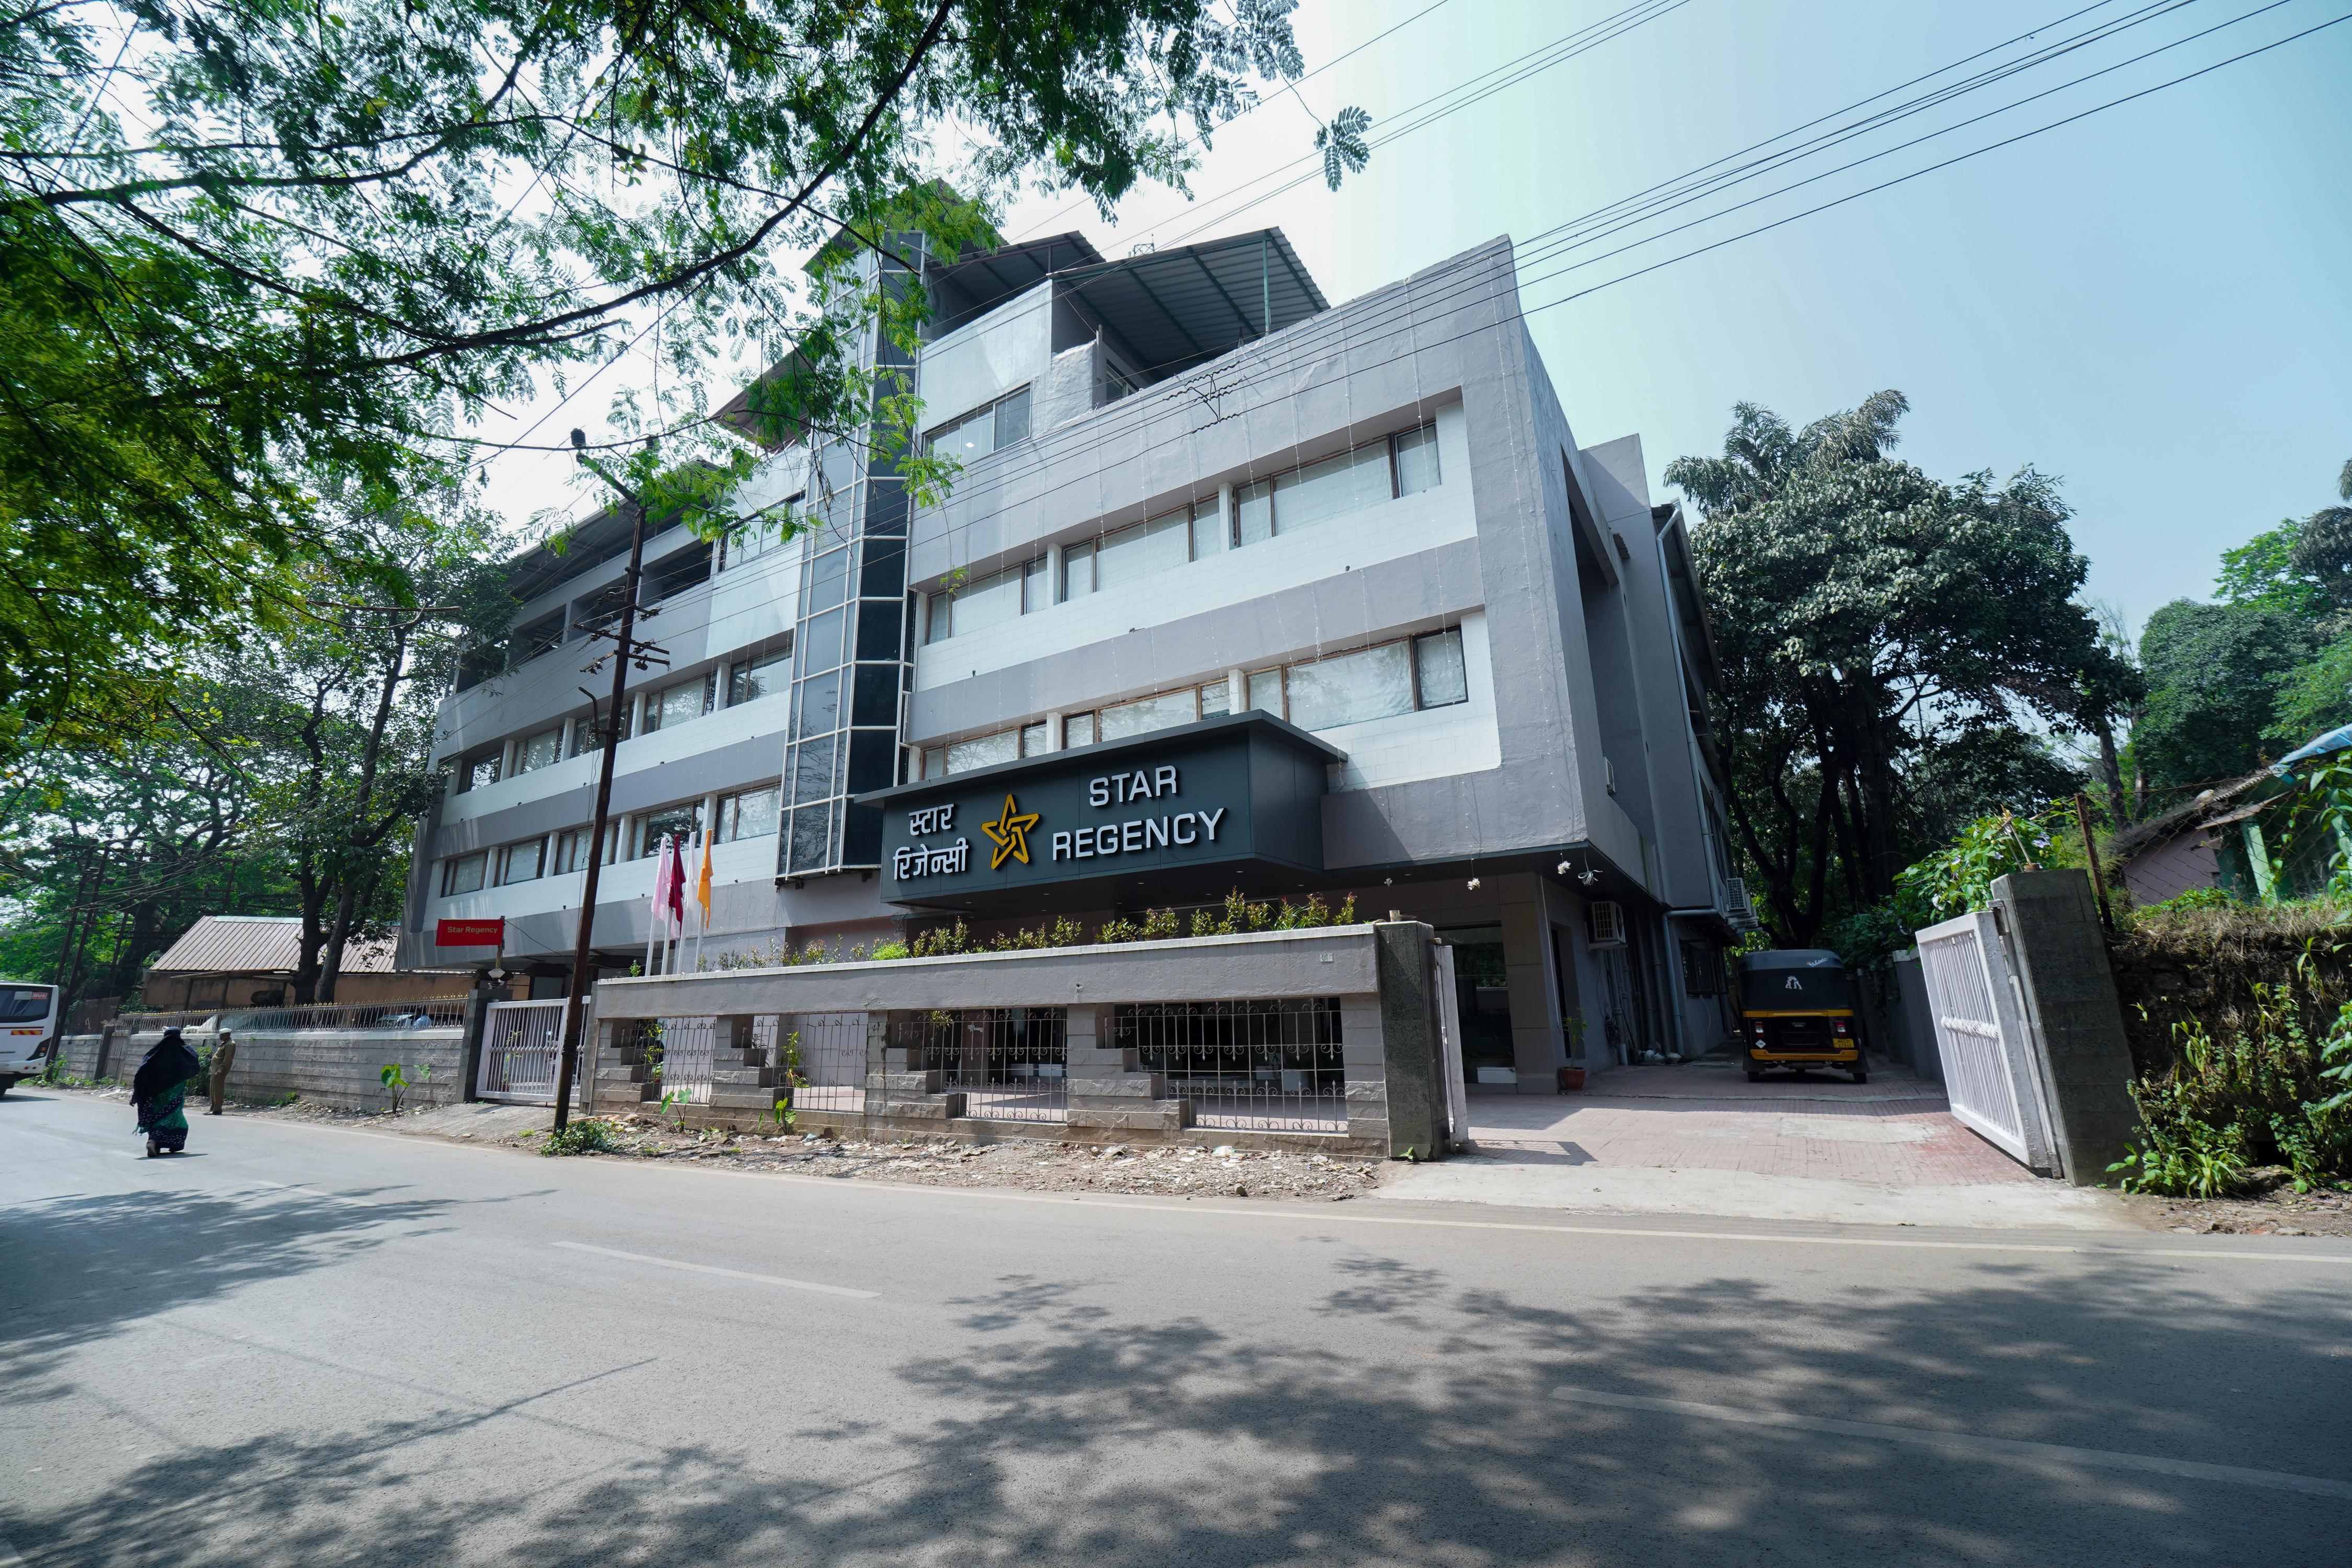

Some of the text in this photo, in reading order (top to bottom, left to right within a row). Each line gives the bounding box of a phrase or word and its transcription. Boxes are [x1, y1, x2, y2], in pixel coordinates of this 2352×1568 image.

[1089, 765, 1177, 806] STAR
[908, 803, 954, 836] स्टार
[1053, 808, 1225, 861] REGENCY
[893, 837, 969, 880] रिजेन्सी
